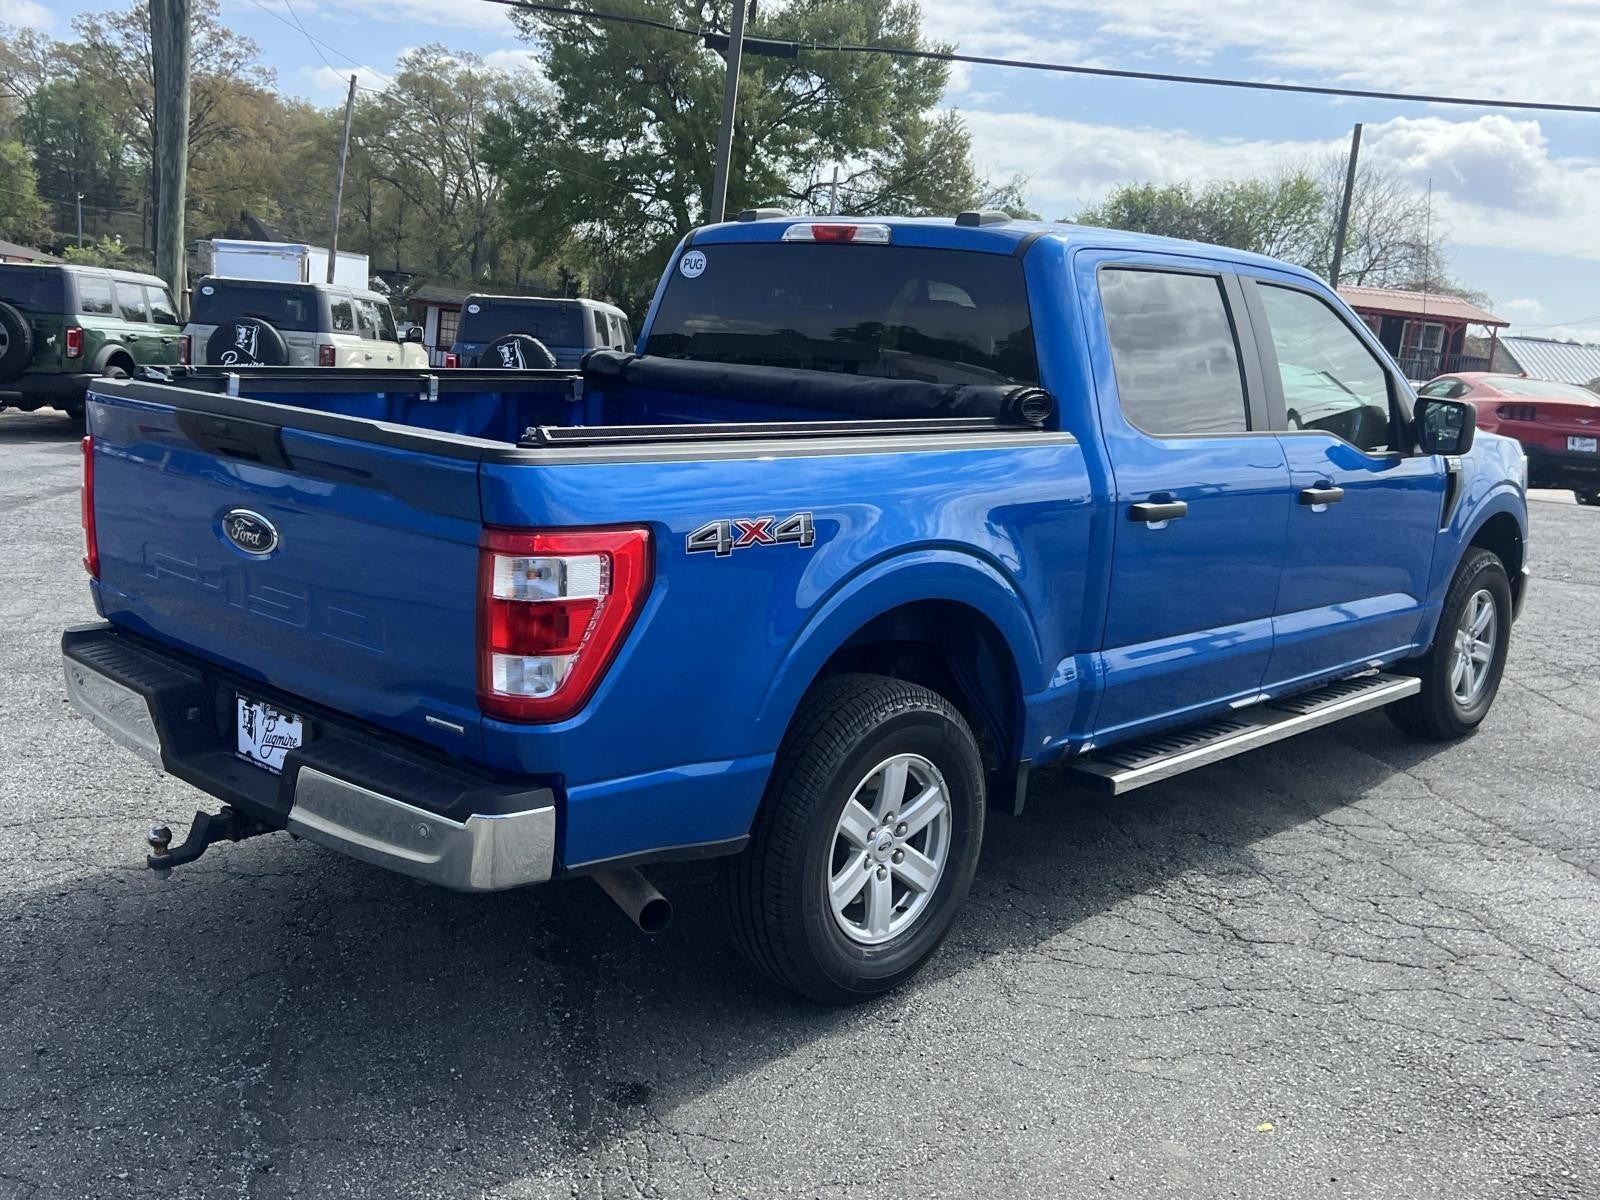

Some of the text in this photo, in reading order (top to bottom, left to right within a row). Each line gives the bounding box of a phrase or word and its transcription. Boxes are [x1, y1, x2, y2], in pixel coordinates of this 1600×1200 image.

[683, 258, 703, 270] PUG
[231, 517, 261, 546] Ford
[260, 715, 299, 760] Pugmire
